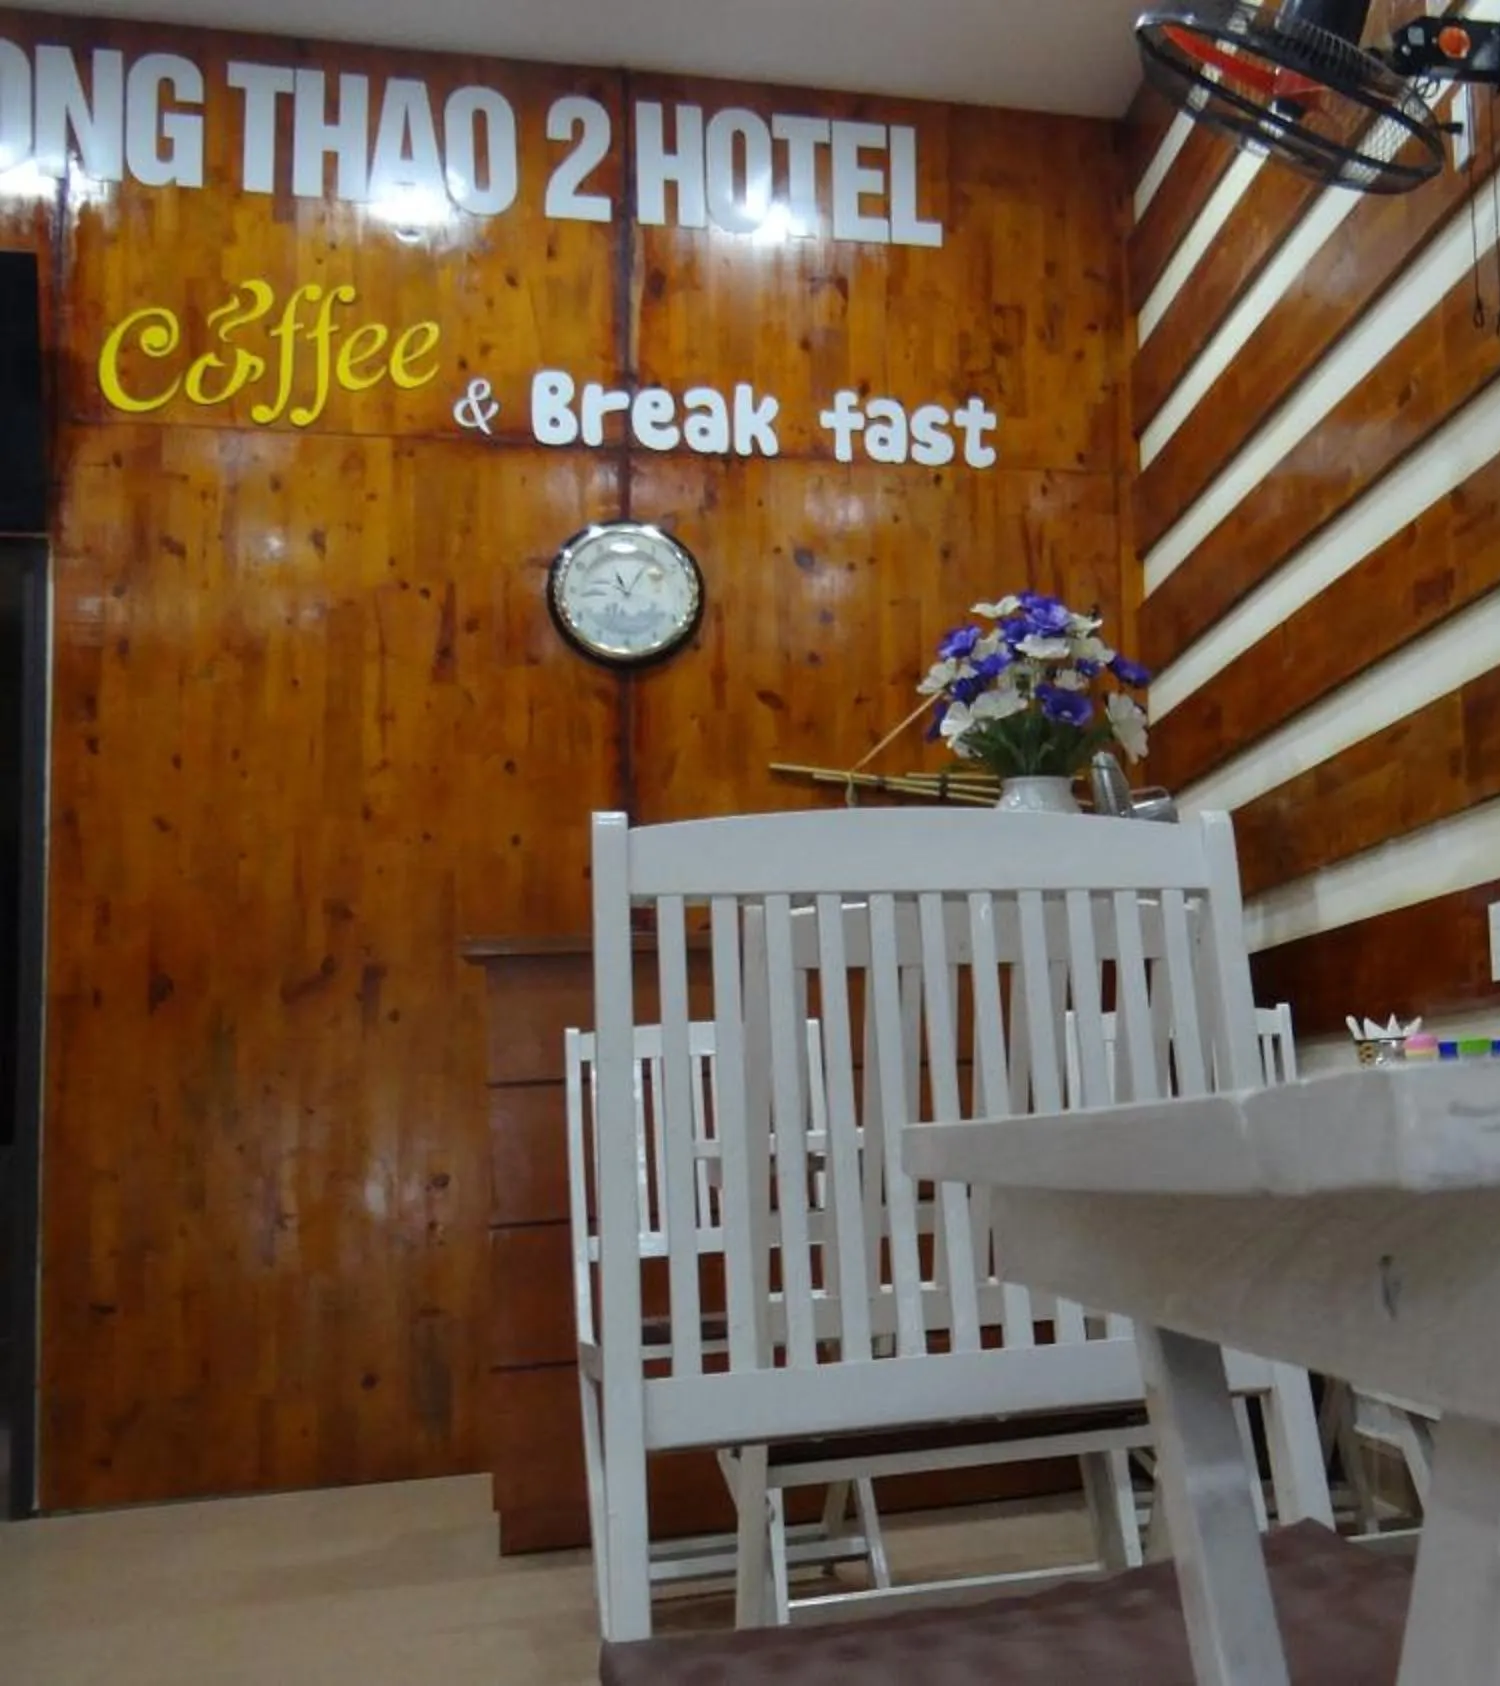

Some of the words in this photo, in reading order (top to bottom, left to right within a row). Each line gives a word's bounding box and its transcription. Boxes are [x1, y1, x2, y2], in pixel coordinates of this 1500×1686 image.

[227, 61, 518, 217] THAO
[544, 97, 611, 223] 2
[635, 101, 943, 248] HOTEL
[98, 279, 440, 426] Coffee
[453, 378, 499, 436] &
[531, 370, 779, 457] Break
[819, 389, 997, 468] fast
